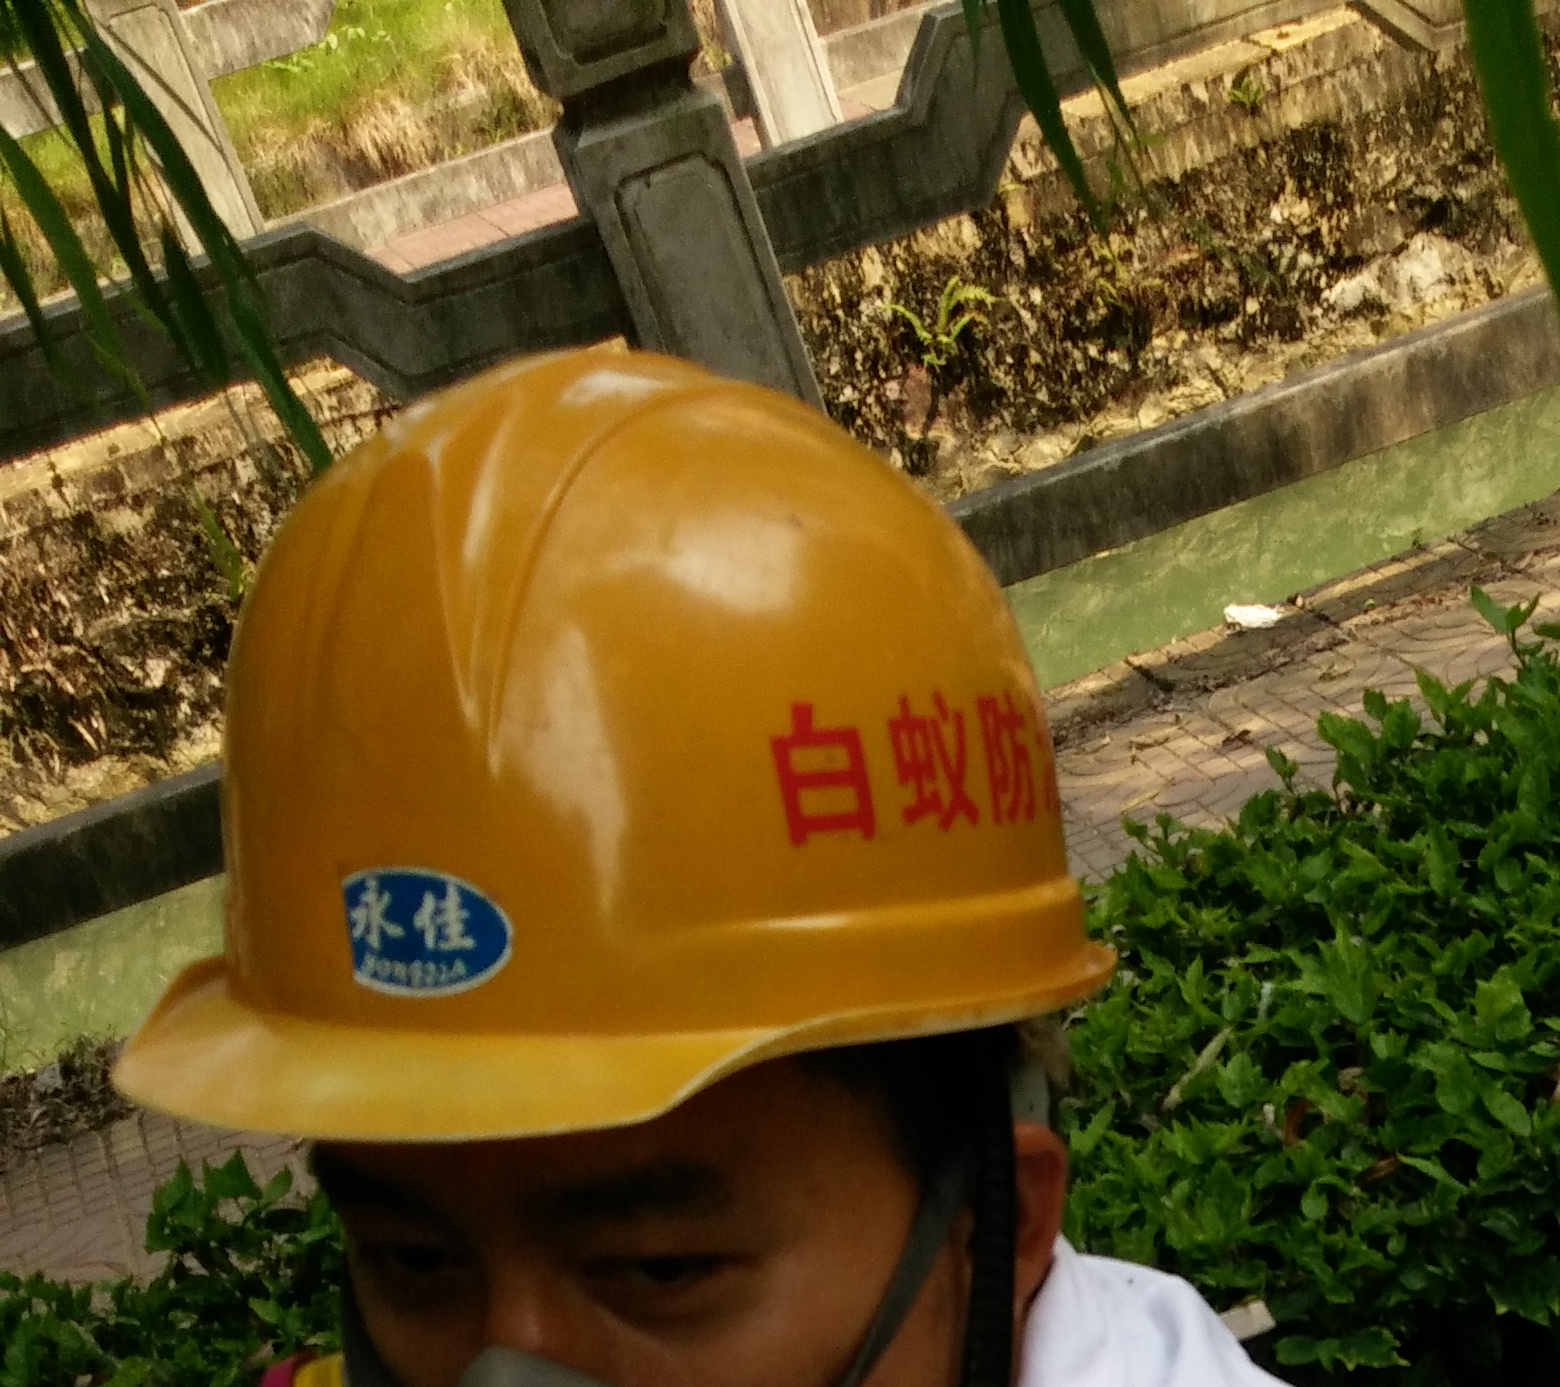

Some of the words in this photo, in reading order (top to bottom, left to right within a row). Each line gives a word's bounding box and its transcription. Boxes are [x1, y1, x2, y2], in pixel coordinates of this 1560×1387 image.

[770, 690, 1060, 848] 白蚁防
[349, 877, 477, 951] 永佳
